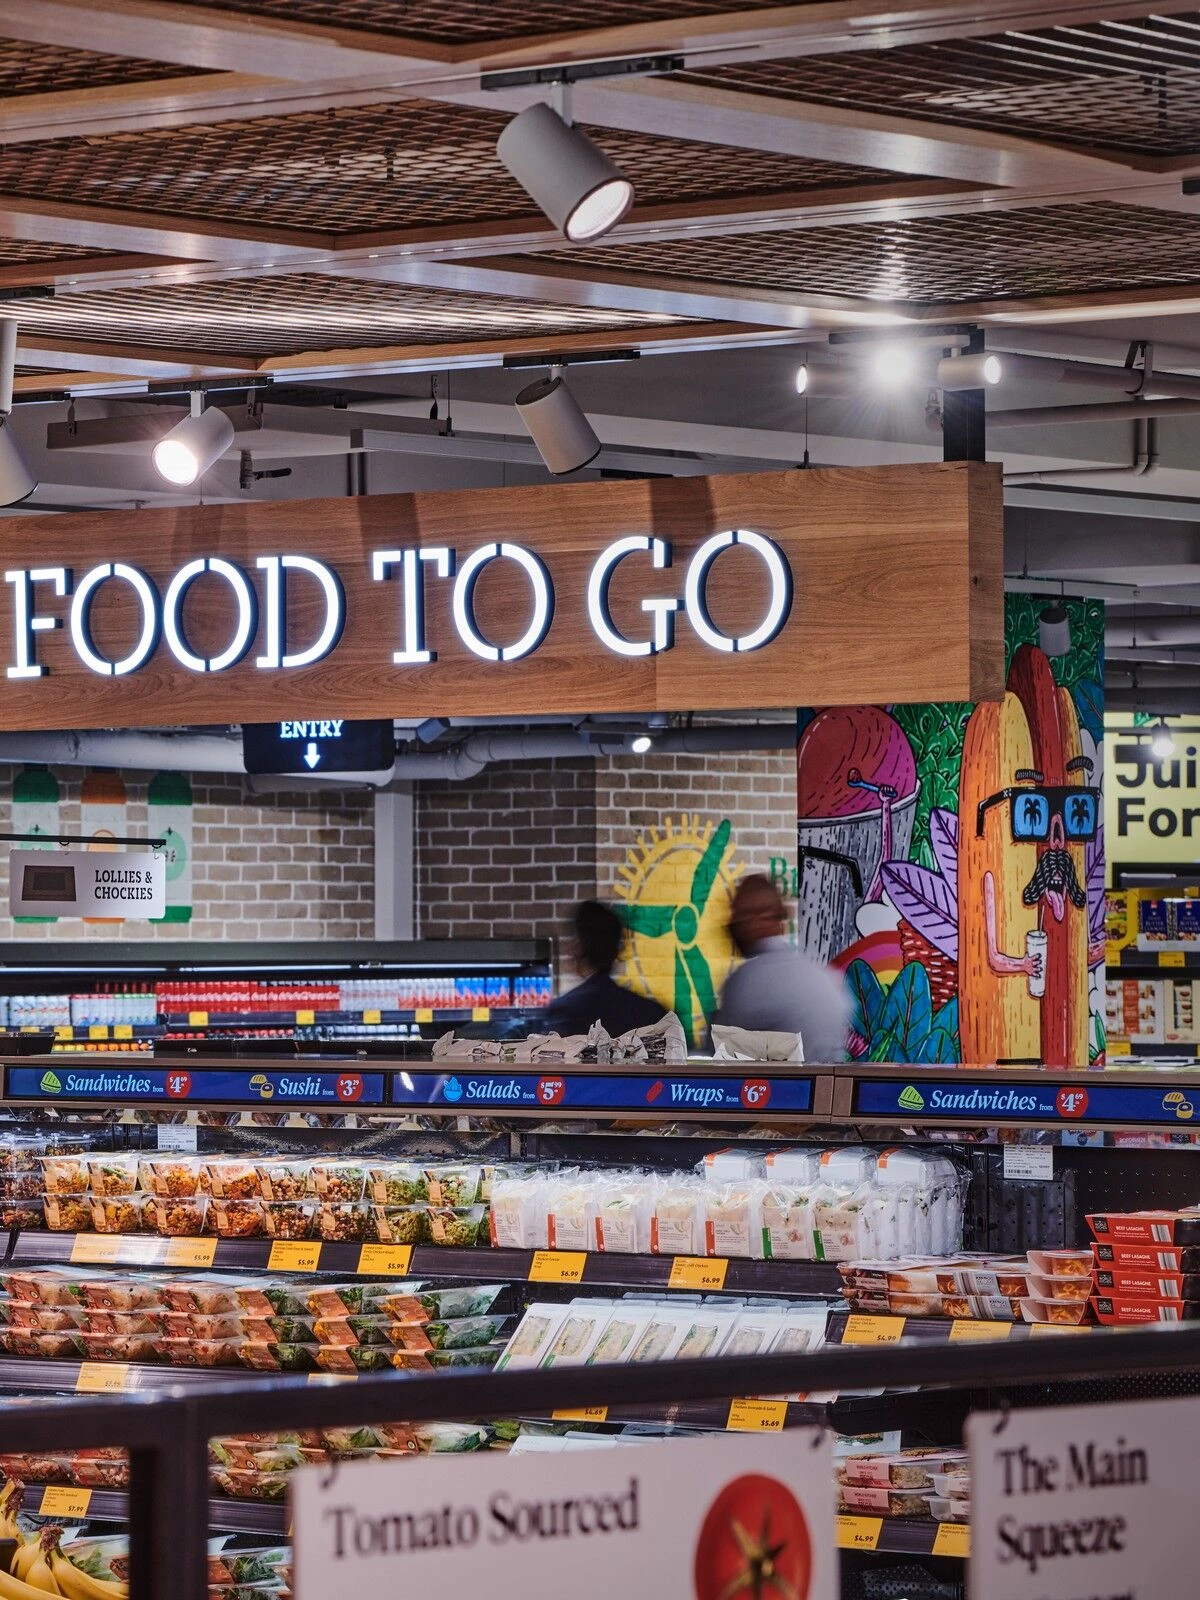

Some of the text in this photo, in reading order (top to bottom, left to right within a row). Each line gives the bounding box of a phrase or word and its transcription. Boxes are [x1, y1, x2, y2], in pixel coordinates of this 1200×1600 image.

[4, 529, 793, 679] FOOD TO GO
[280, 720, 344, 738] ENTRY
[95, 869, 153, 884] LOLLIES &
[94, 886, 153, 900] CHOCKIES
[65, 1074, 151, 1093] Sandwiches
[278, 1077, 322, 1096] Sushi
[466, 1080, 521, 1099] Salads
[670, 1084, 724, 1107] Wraps
[929, 1089, 1037, 1111] Sandwiches
[1039, 1103, 1054, 1111] from
[995, 1437, 1148, 1497] The Main
[322, 1474, 640, 1562] Tomato Sourced
[854, 1534, 874, 1542] $4.99
[996, 1514, 1127, 1575] Squeeze
